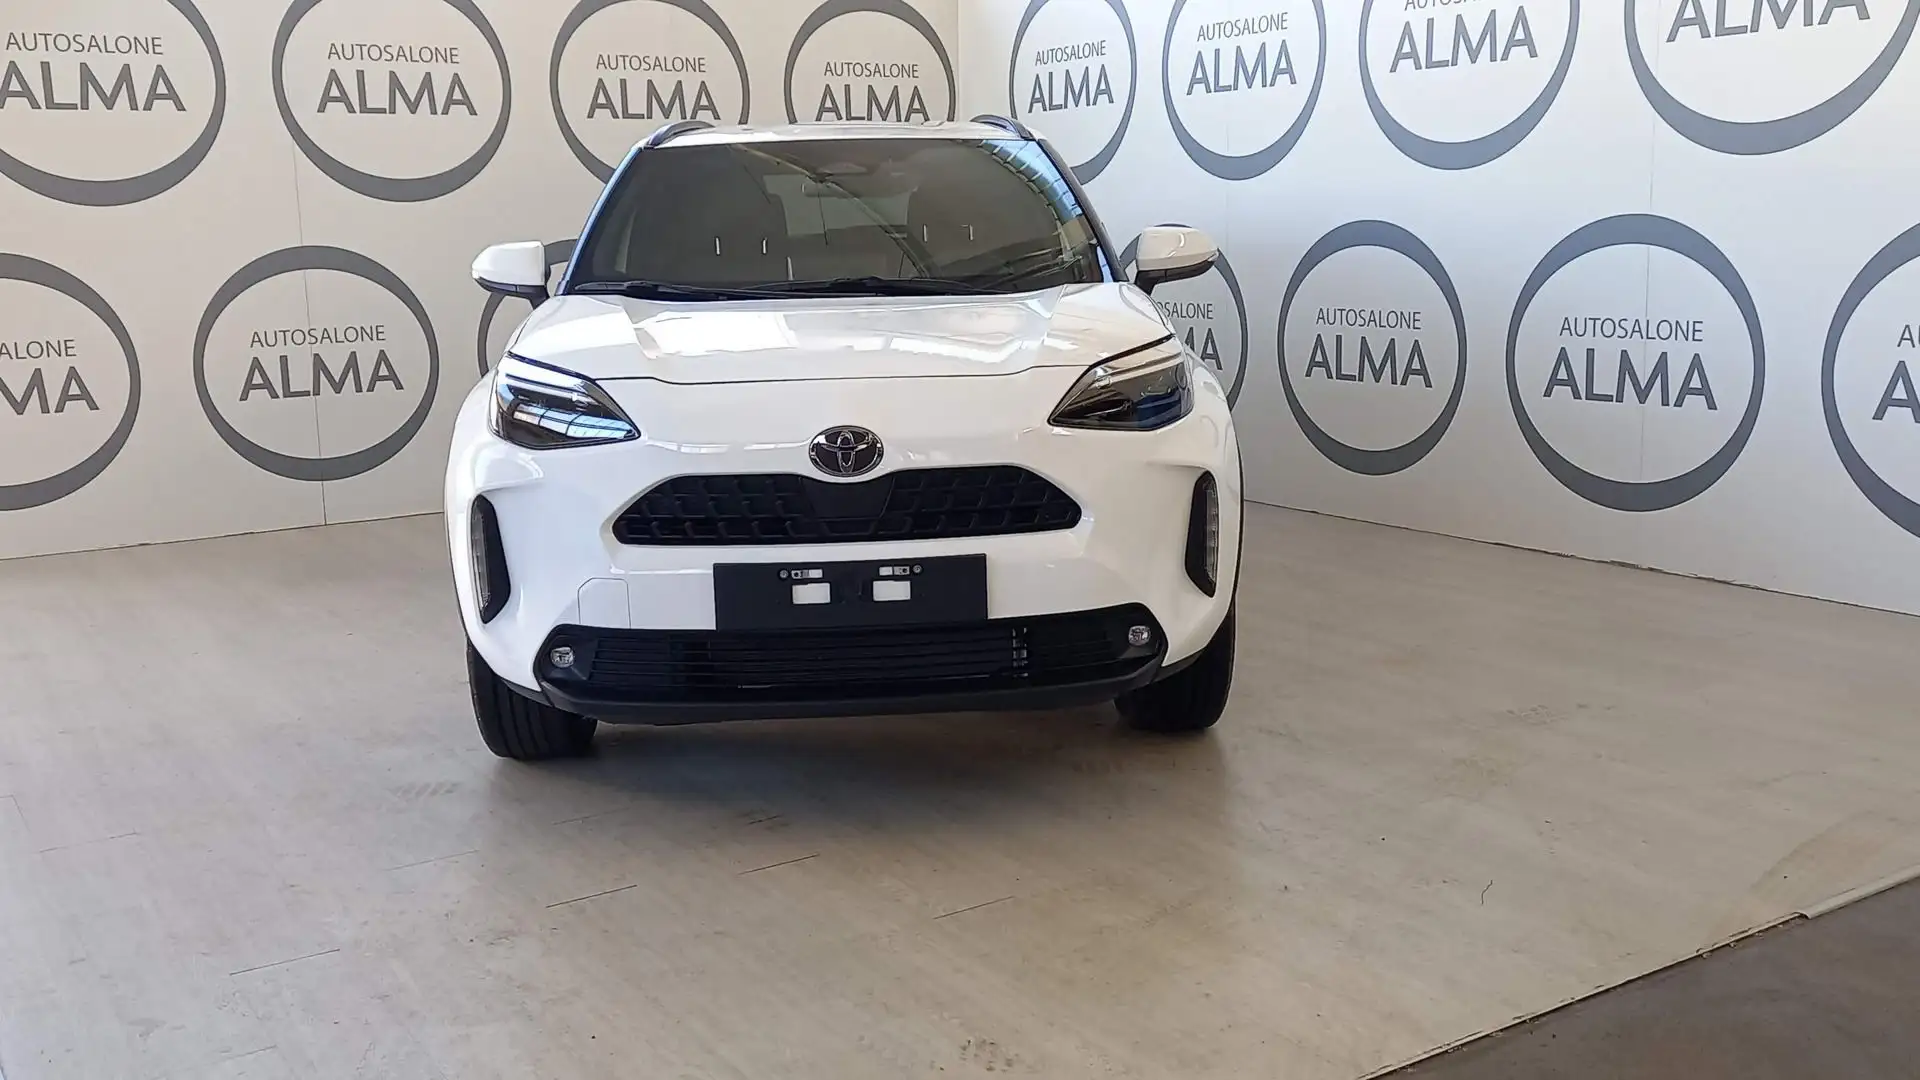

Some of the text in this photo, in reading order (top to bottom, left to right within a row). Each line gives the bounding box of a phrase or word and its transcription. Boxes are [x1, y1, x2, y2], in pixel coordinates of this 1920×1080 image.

[6, 32, 164, 55] AUTOSALONE
[1197, 12, 1288, 42] AUTOSALONE
[1389, 5, 1539, 73] ALMA
[328, 43, 459, 64] AUTOSALONE
[596, 54, 706, 72] AUTOSALONE
[824, 62, 919, 78] AUTOSALONE
[1035, 40, 1106, 66] AUTOSALONE
[1186, 39, 1297, 95] ALMA
[0, 61, 187, 111] ALMA
[317, 69, 479, 116] ALMA
[587, 78, 721, 120] ALMA
[815, 84, 930, 122] ALMA
[1028, 64, 1114, 113] ALMA
[250, 325, 386, 348] AUTOSALONE
[1316, 308, 1421, 329] AUTOSALONE
[1560, 317, 1704, 341] AUTOSALONE
[239, 350, 405, 401] ALMA
[1305, 334, 1433, 388] ALMA
[1543, 347, 1718, 410] ALMA
